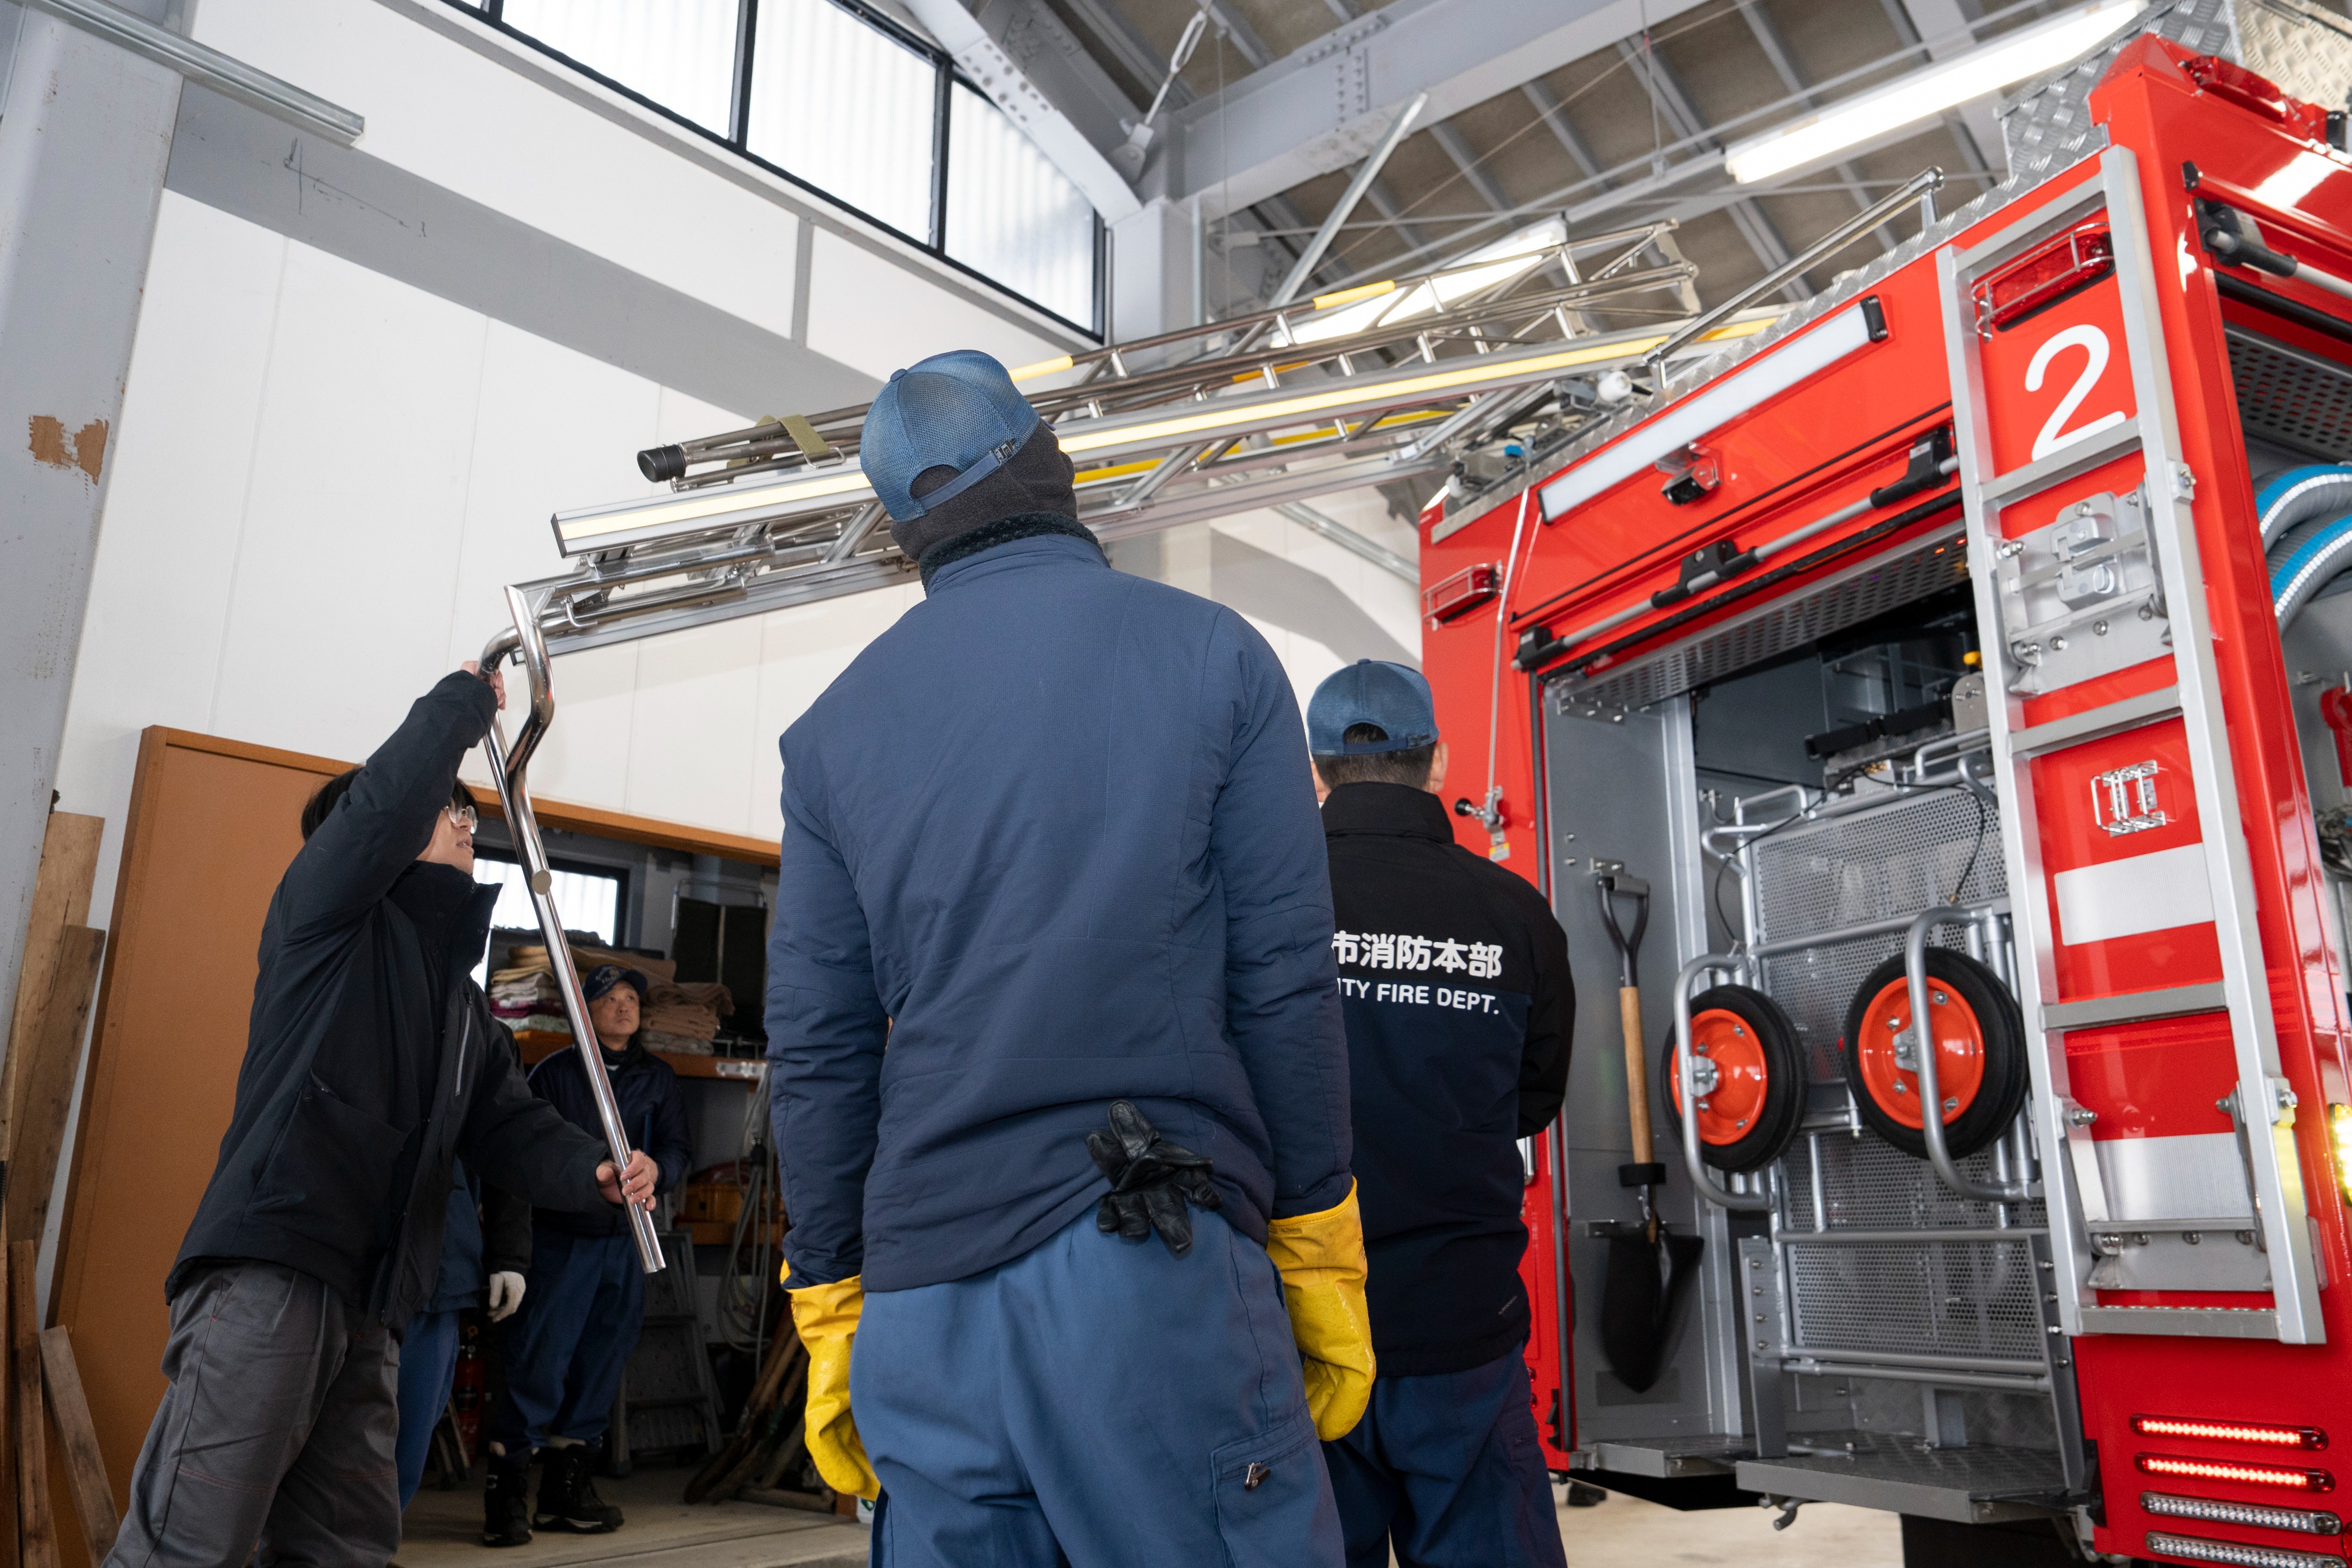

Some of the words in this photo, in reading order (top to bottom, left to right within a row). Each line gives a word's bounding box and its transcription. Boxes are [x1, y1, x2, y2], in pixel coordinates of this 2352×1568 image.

[2025, 324, 2126, 462] 2
[1331, 930, 1503, 979] 市消防本部
[1377, 983, 1429, 1004] FIRE
[1437, 988, 1499, 1015] DEPT.
